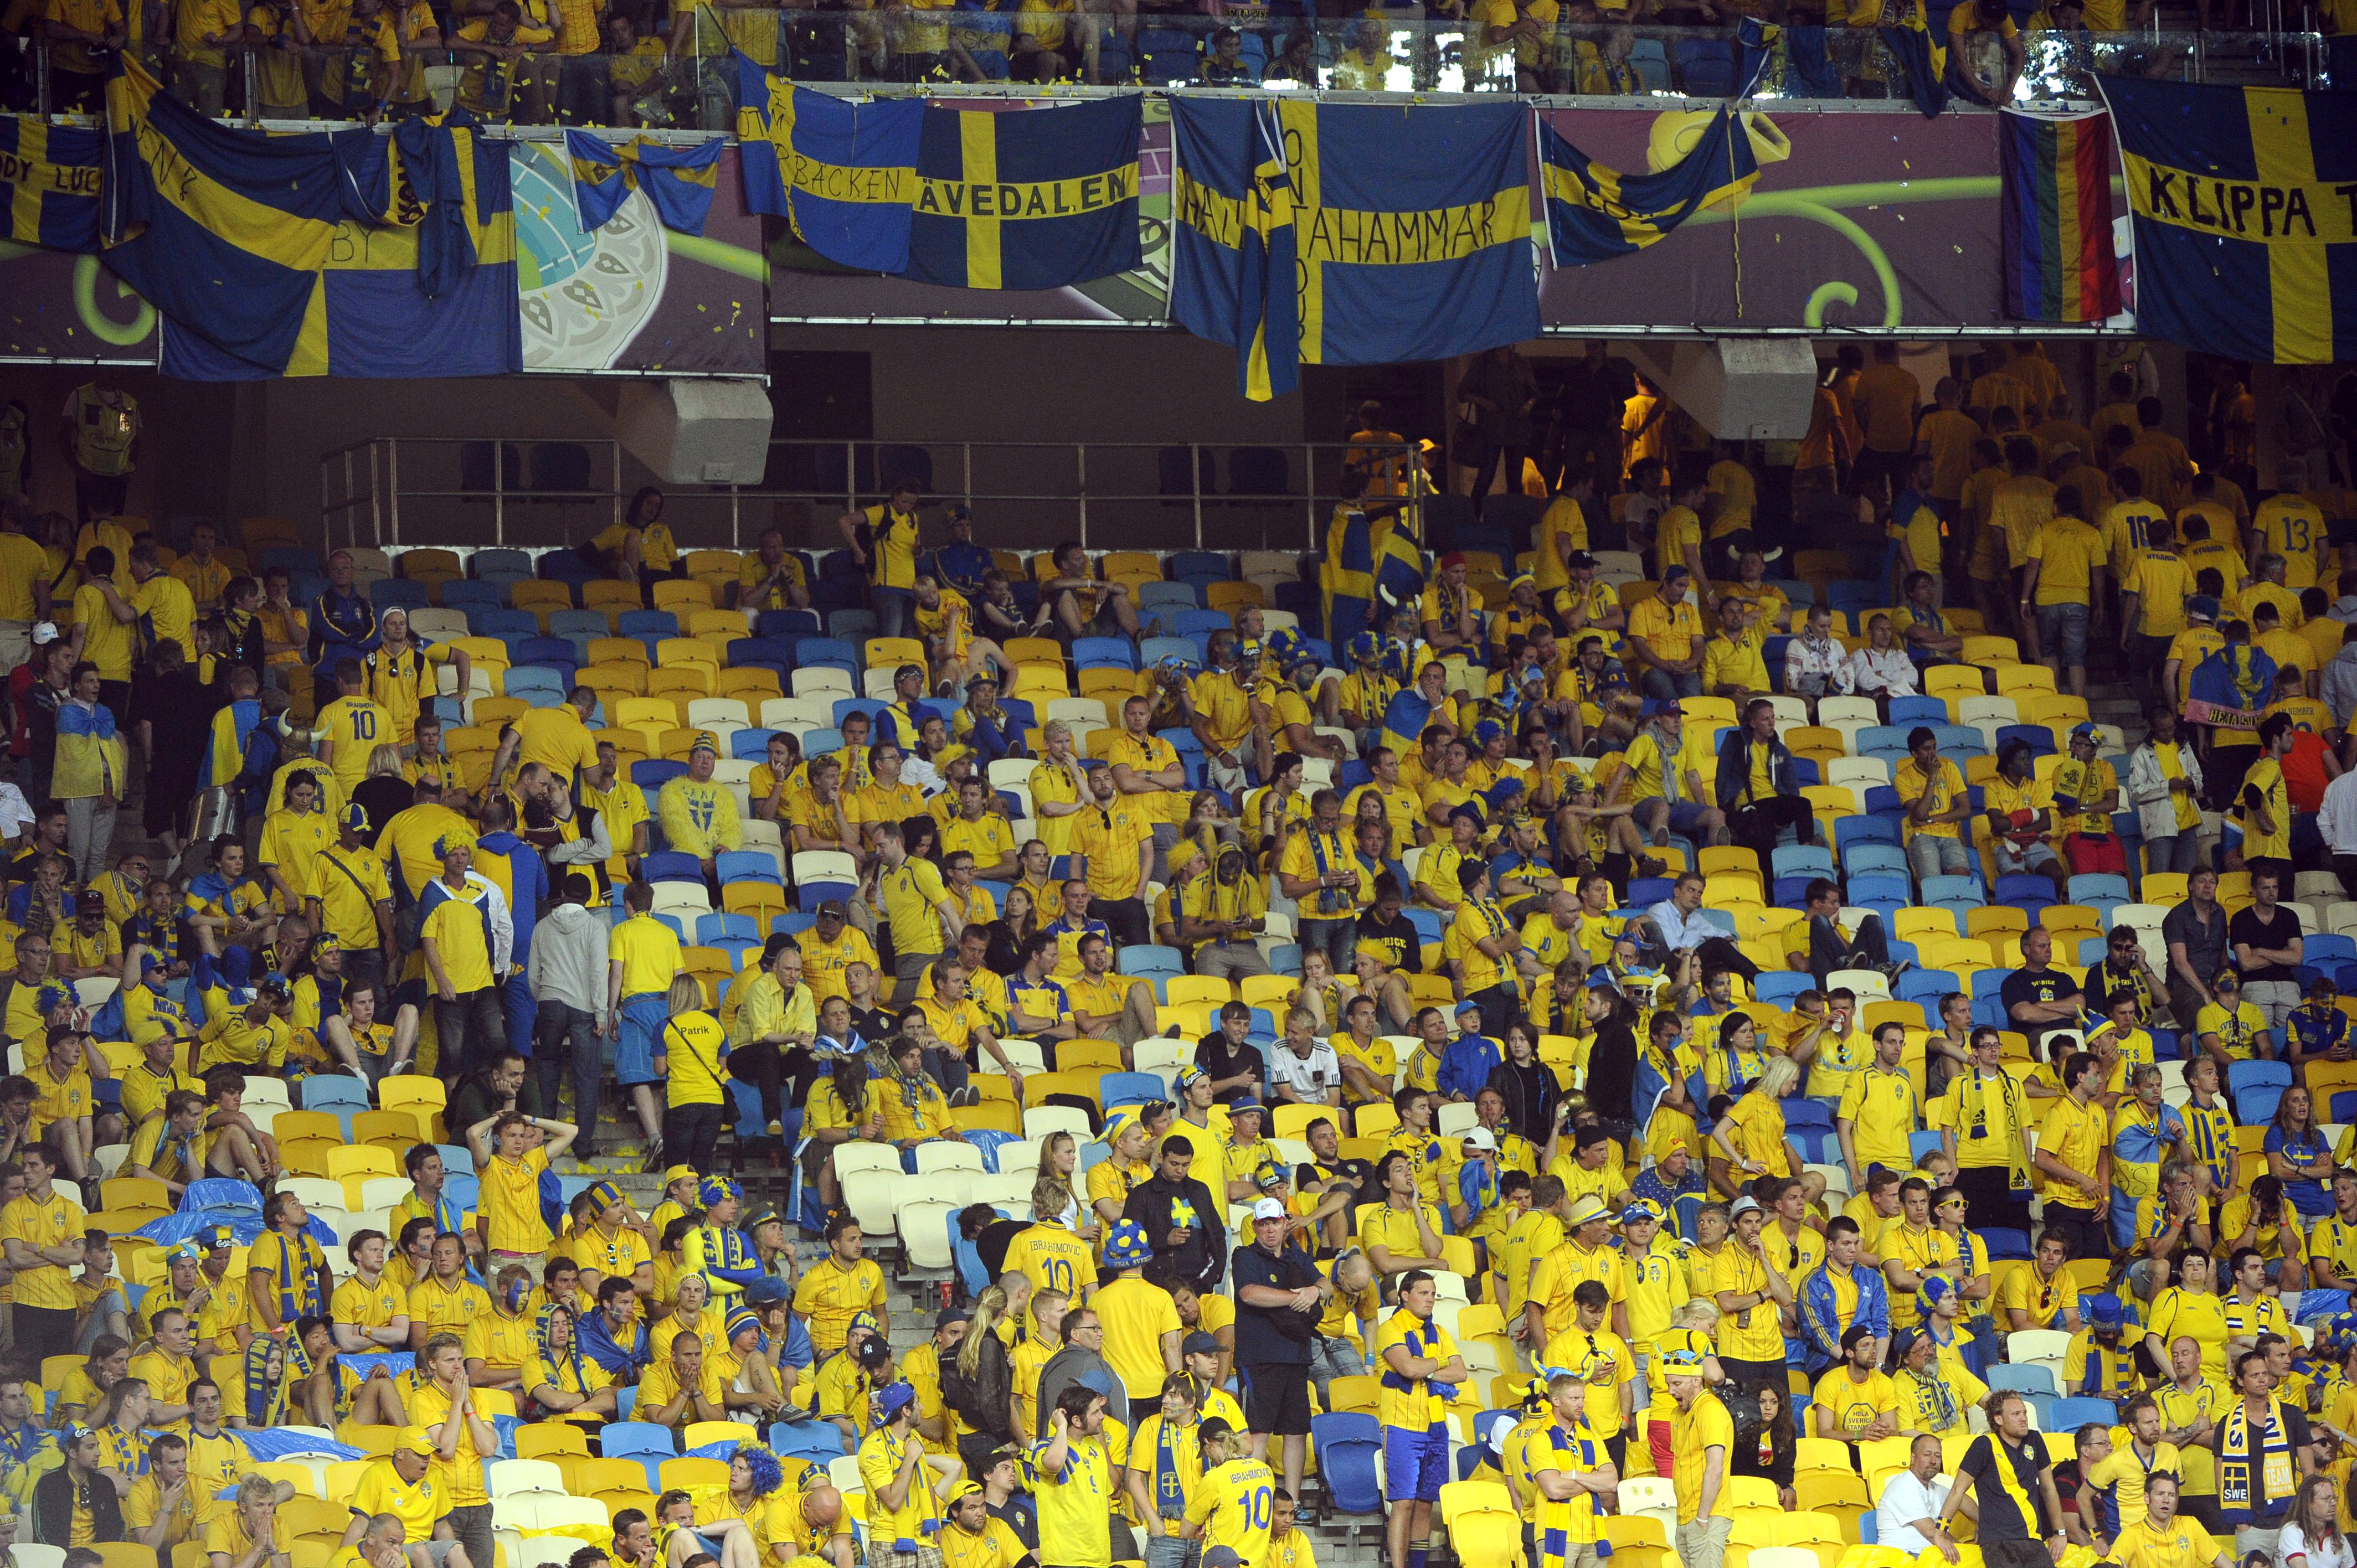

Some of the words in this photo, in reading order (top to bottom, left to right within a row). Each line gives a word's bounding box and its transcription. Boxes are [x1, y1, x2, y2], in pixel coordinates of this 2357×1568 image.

[56, 167, 102, 193] LUC
[792, 155, 900, 199] BÄCKEN
[919, 167, 1126, 216] ÄVEDALEN
[2150, 167, 2317, 237] KLIPPA
[2126, 515, 2152, 549] 10
[2281, 516, 2310, 553] 13
[349, 709, 376, 740] 10
[2208, 708, 2239, 726] HEJA
[681, 1025, 709, 1035] Patrik
[2220, 1020, 2251, 1033] SVEIGE
[1029, 1241, 1081, 1256] IBRAHIMOVIC
[1041, 1256, 1074, 1299] 10
[1229, 1467, 1272, 1484] IBRAHIMOVIC
[2266, 1466, 2291, 1486] TEAM
[2224, 1488, 2247, 1499] SWE
[1237, 1486, 1273, 1534] 10
